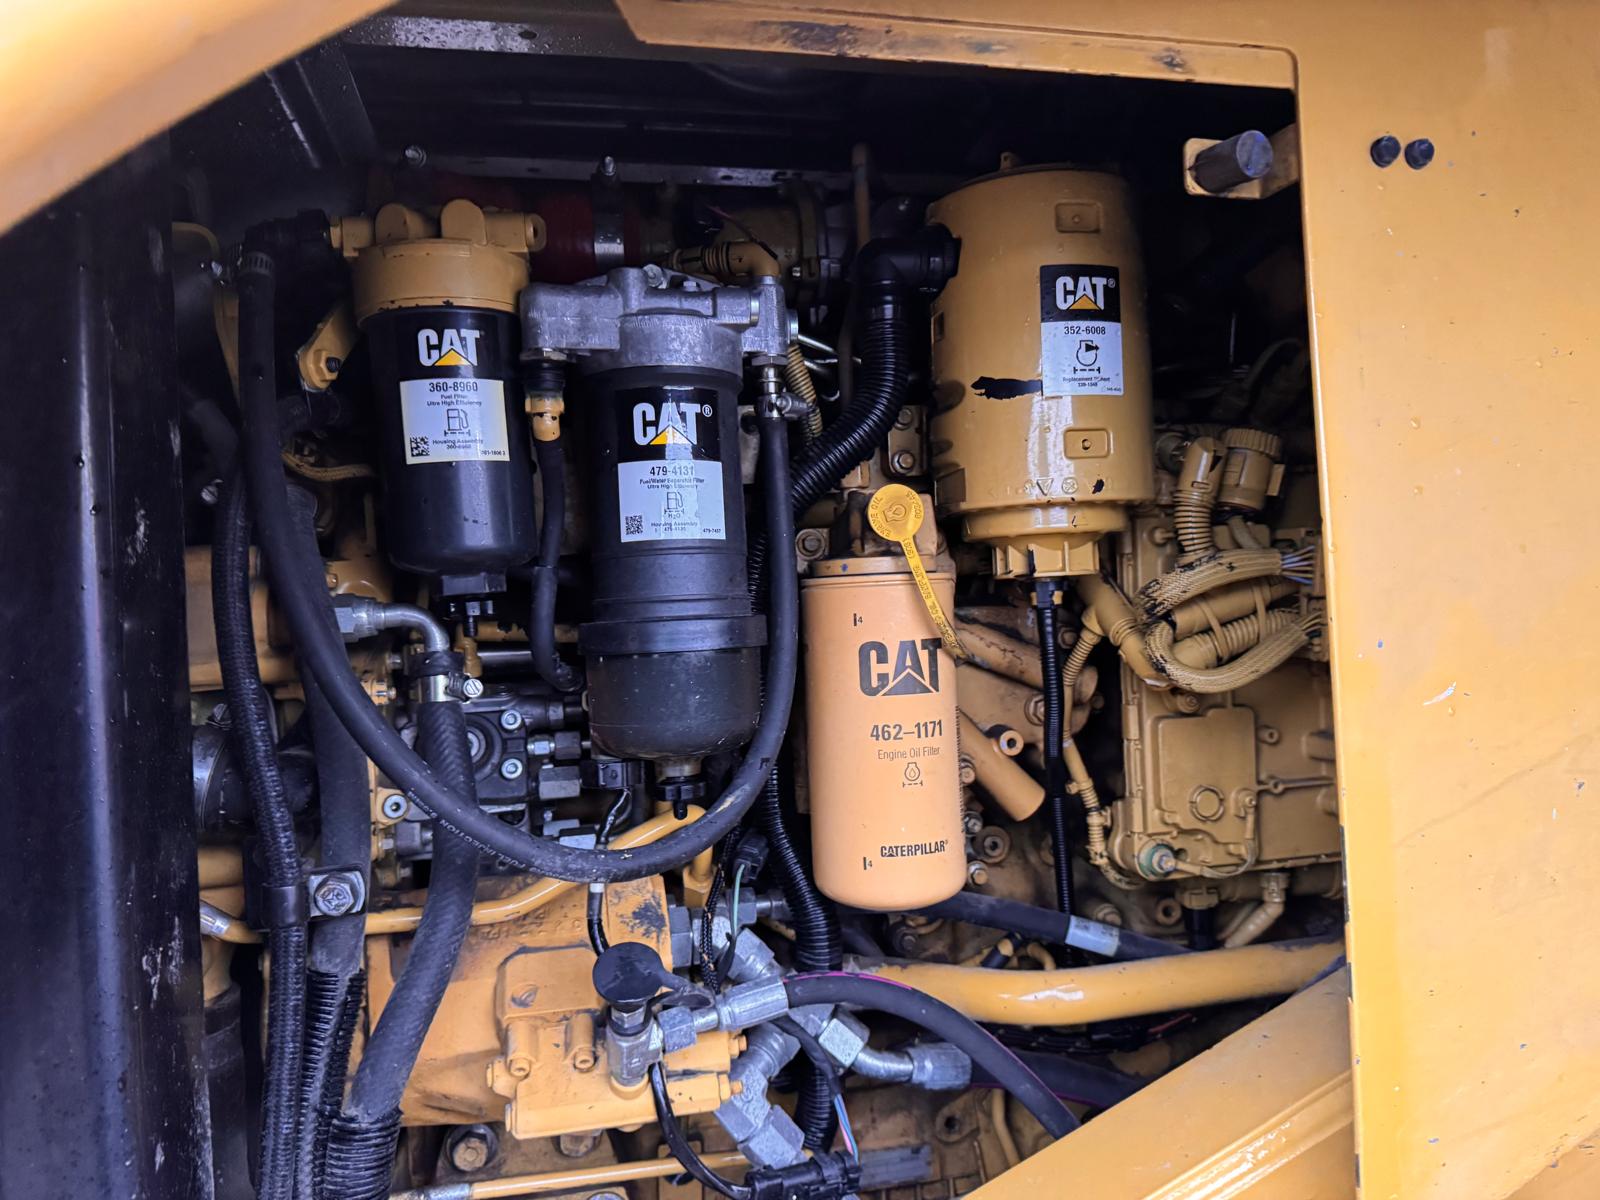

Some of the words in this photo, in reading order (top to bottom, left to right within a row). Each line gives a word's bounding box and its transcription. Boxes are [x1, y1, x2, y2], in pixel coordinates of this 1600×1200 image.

[1063, 325, 1106, 335] 352-6008
[428, 381, 479, 393] 360-8960
[649, 465, 694, 476] 479-4131
[858, 637, 943, 697] CAT
[877, 748, 907, 761] Engine
[909, 747, 921, 759] Oil
[922, 745, 941, 757] Filter
[438, 818, 497, 857] INJECTION
[497, 852, 526, 869] FUEL
